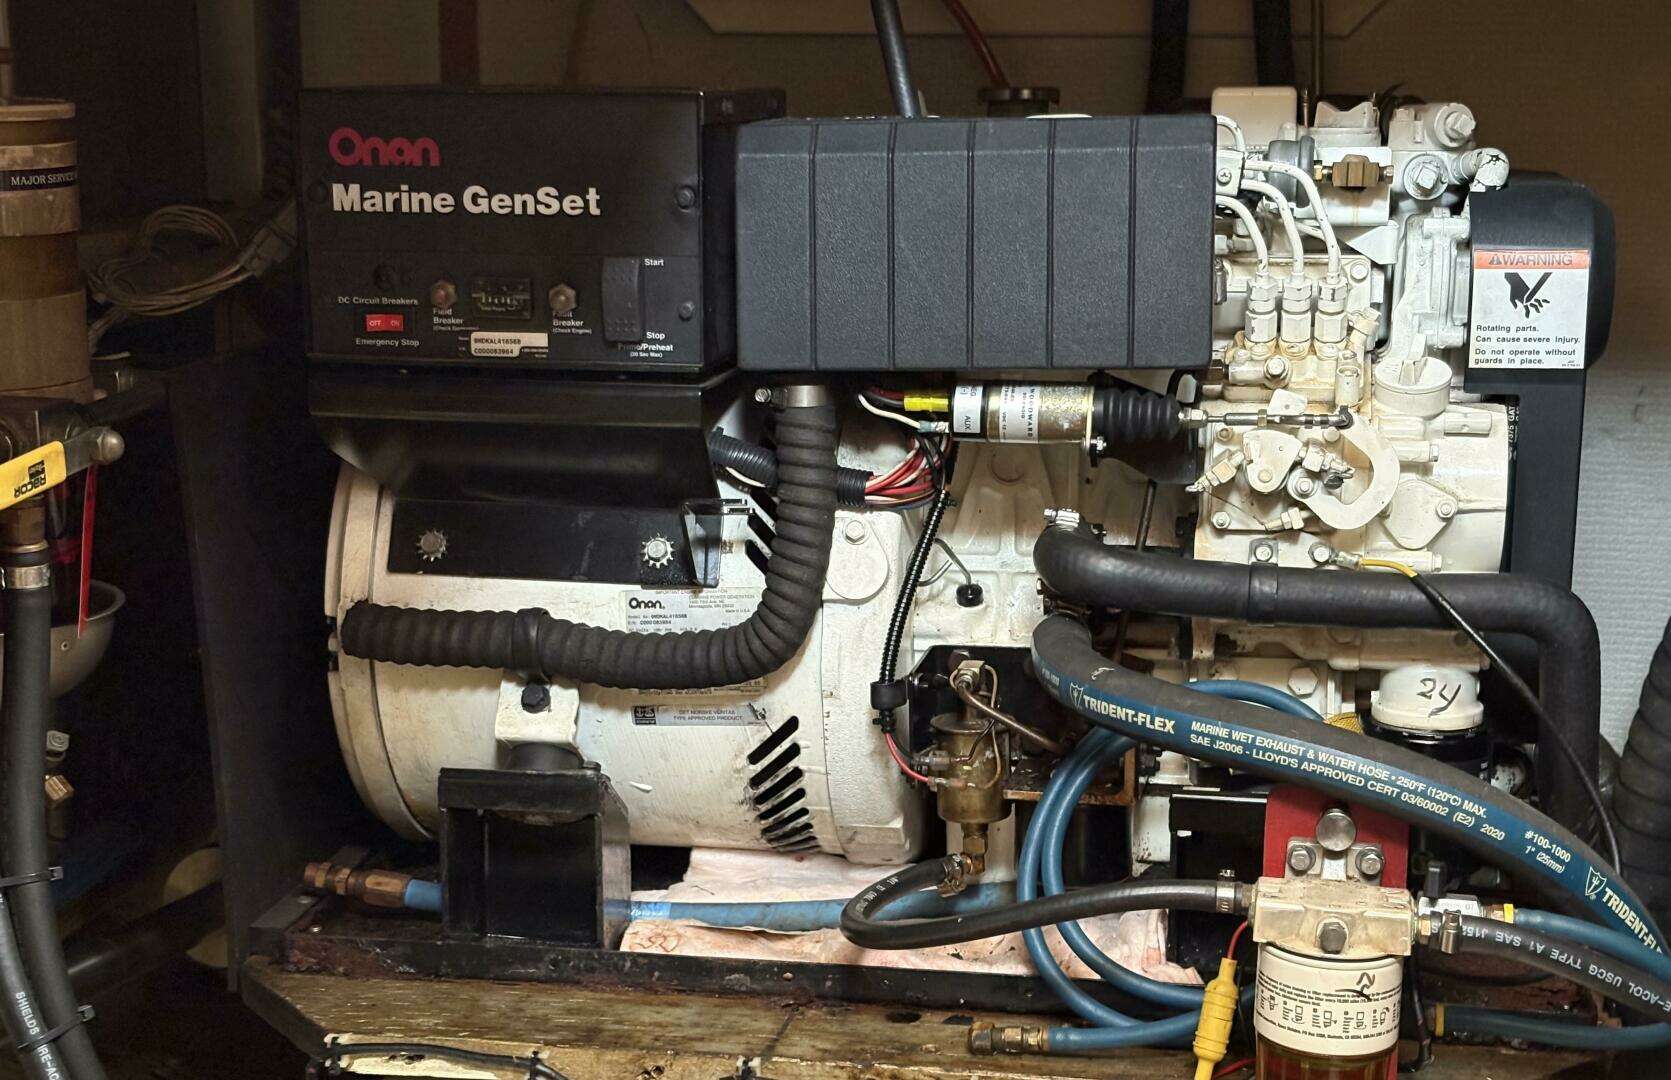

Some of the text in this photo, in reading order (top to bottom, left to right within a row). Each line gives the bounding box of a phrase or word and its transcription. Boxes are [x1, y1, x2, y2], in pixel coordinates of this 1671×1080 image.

[329, 127, 441, 167] Onan
[11, 175, 47, 186] MAJOR
[332, 183, 601, 216] Marine GenSet
[644, 258, 664, 266] Start
[1502, 254, 1573, 266] WARNING
[338, 296, 418, 305] DC Circuit Breakers
[433, 316, 464, 324] Breaker
[646, 331, 666, 341] Stop
[1476, 325, 1539, 334] Rotating parts.
[355, 338, 420, 347] Emergency Stop
[1555, 336, 1581, 345] injury.
[1474, 357, 1502, 366] guards
[1520, 357, 1545, 366] place.
[1509, 349, 1540, 358] operate
[1027, 388, 1036, 438] WOODWARD
[14, 474, 47, 498] RACOR
[628, 597, 662, 609] Onan
[1083, 695, 1176, 734] TRIDENT-FLEX
[1191, 721, 1488, 819] MARINE WET EXHAUST & WATER HOSE 250°F (120°C) MAX.
[1190, 734, 1211, 747] SAE
[1213, 740, 1244, 754] J2006
[1252, 748, 1299, 769] LLOYD'S
[1301, 762, 1365, 787] APPROVED
[1367, 780, 1400, 798] CERT
[1400, 791, 1449, 817] 03/60002
[1452, 810, 1476, 829] (E2)
[1480, 823, 1506, 841] 2020
[1524, 830, 1572, 863] #100-1000
[1536, 851, 1566, 875] (25mm)
[1603, 887, 1662, 954] TRIDENT-FL
[1461, 924, 1488, 939] J152
[1495, 931, 1522, 947] SAE
[1529, 938, 1546, 954] A1
[1550, 948, 1582, 971] TYPE
[1588, 963, 1622, 988] USCG
[15, 991, 40, 1035] SHIELDS
